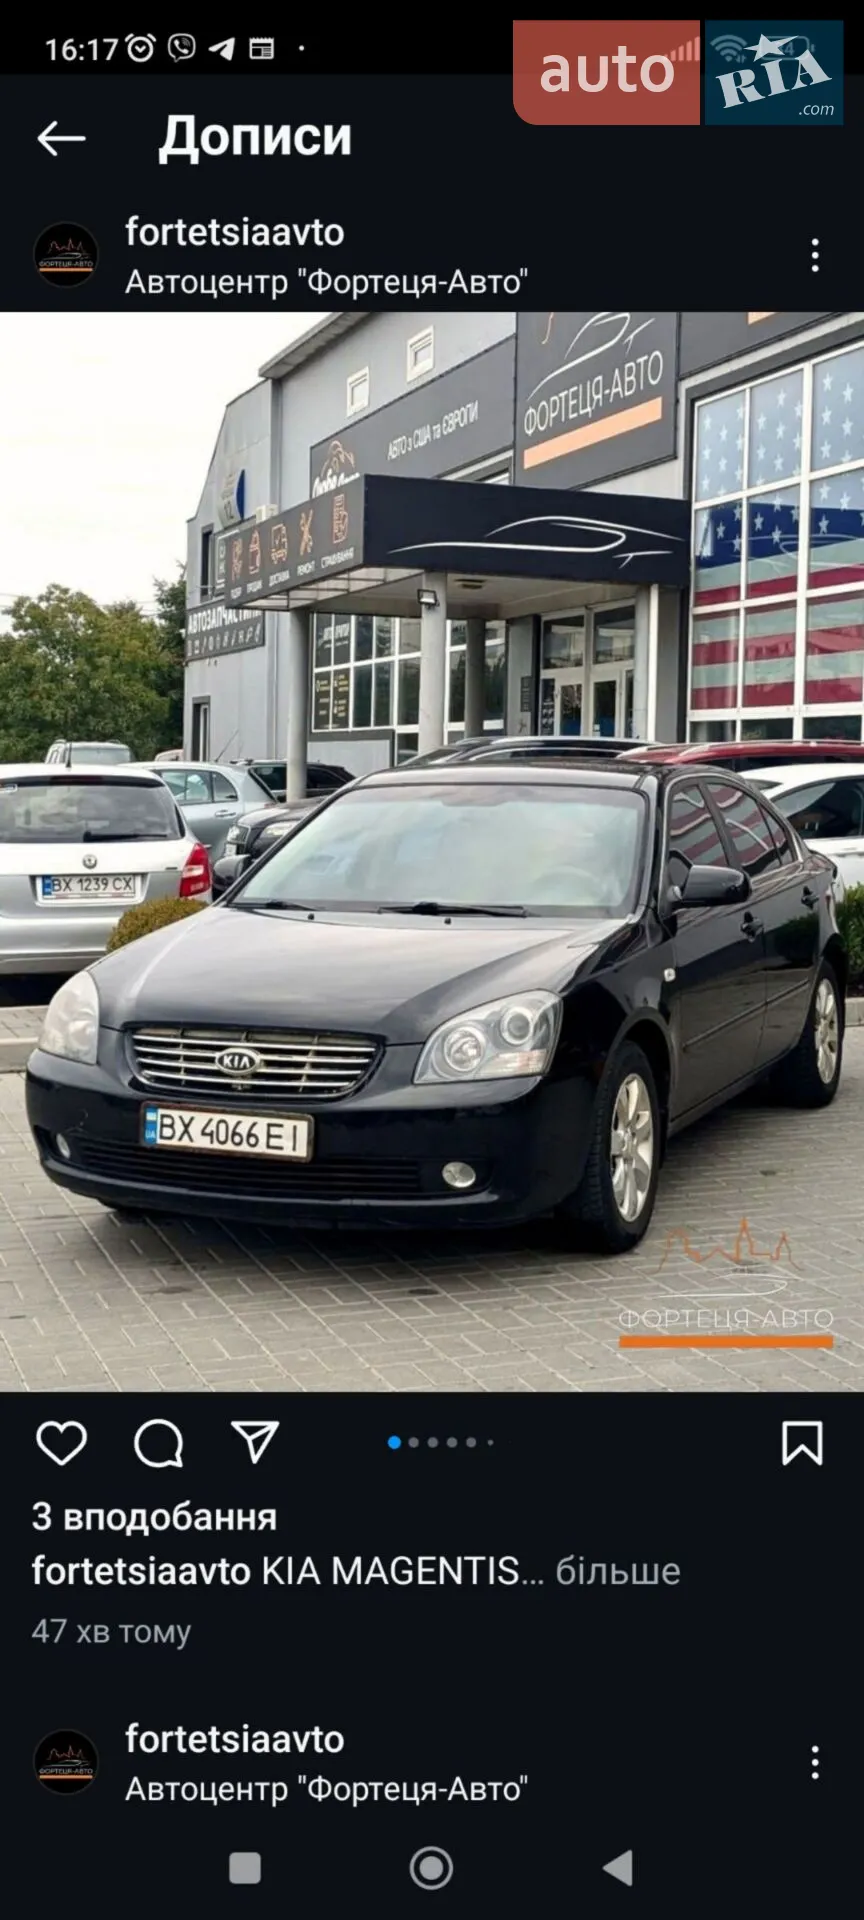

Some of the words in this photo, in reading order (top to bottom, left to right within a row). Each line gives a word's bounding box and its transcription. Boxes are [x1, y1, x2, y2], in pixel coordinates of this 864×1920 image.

[45, 38, 119, 62] 16:17
[158, 114, 352, 165] Дописи
[124, 214, 345, 247] fortetsiaavto
[124, 269, 289, 302] Автоцентр
[297, 267, 529, 302] "Фортеця-Авто"
[523, 349, 664, 437] ФОРТЕЦЯ-АВТО
[387, 435, 407, 461] АВТО
[413, 424, 432, 449] США
[442, 399, 479, 436] ЄВРОПИ
[52, 877, 72, 893] BX
[77, 877, 109, 892] 1239
[112, 876, 133, 891] CX
[221, 1055, 250, 1070] KIA
[159, 1113, 195, 1143] BX
[200, 1118, 260, 1148] 4066
[32, 1501, 52, 1531] 3
[64, 1500, 277, 1536] вподобання
[32, 1554, 252, 1586] fortetsiaavto
[263, 1555, 322, 1585] KIA
[556, 1554, 681, 1586] більше
[31, 1618, 68, 1644] 47
[76, 1624, 110, 1644] хв
[118, 1624, 192, 1651] тому
[124, 1721, 345, 1754] fortetsiaavto
[124, 1776, 289, 1809] Автоцентр
[298, 1774, 529, 1809] "Фортеця-Авто"
